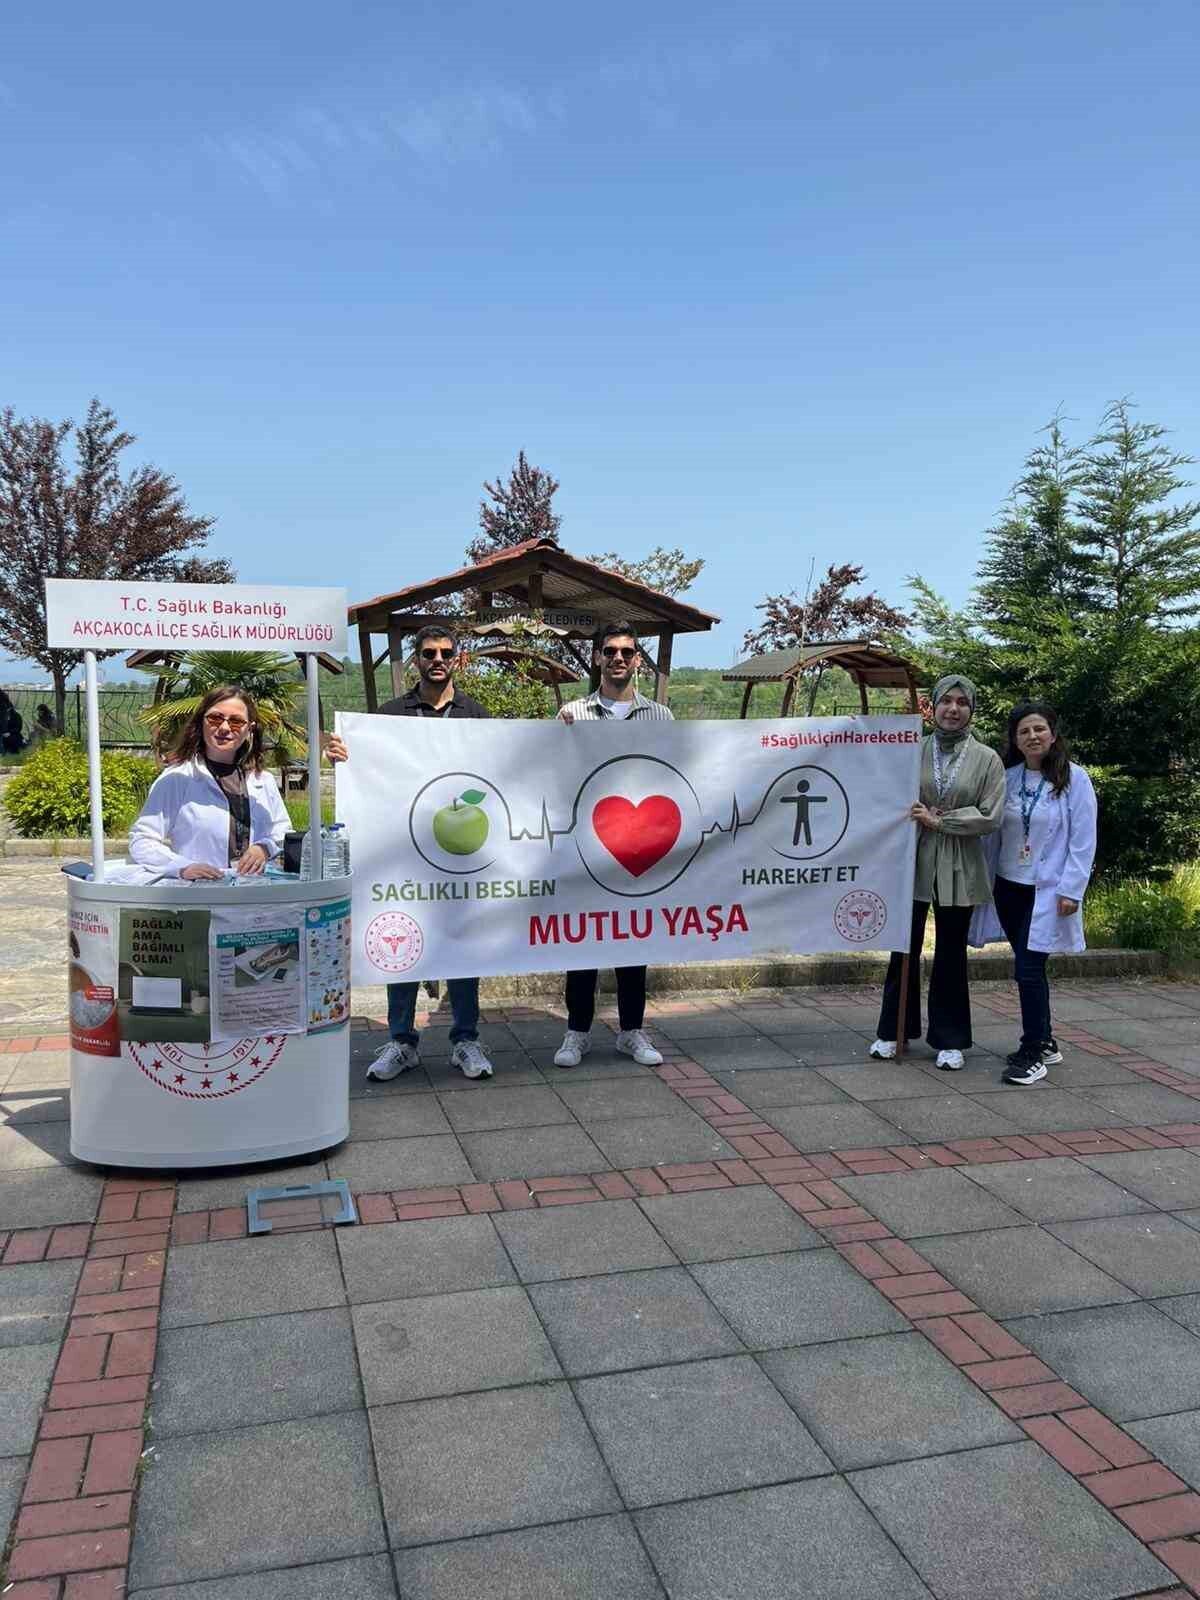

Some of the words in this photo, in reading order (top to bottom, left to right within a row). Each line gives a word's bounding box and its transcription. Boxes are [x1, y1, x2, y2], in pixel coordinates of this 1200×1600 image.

[120, 597, 151, 612] T.C.
[158, 598, 208, 617] Sağlık
[213, 600, 287, 619] Bakanlığı
[73, 620, 152, 638] AKÇAKOCA
[156, 620, 188, 640] İLÇE
[191, 621, 242, 640] SAĞLIK
[246, 622, 334, 641] MÜDÜRLÜĞÜ
[742, 867, 832, 885] HAREKET
[836, 866, 860, 882] ET
[371, 880, 469, 902] SAĞLIKLI
[476, 879, 556, 899] BESLEN
[132, 917, 184, 930] BAĞLAN
[529, 908, 653, 945] MUTLU
[661, 903, 749, 941] YAŞA
[132, 930, 161, 940] AMA
[132, 942, 185, 953] BAĞIMLI
[132, 954, 173, 964] OLMA!
